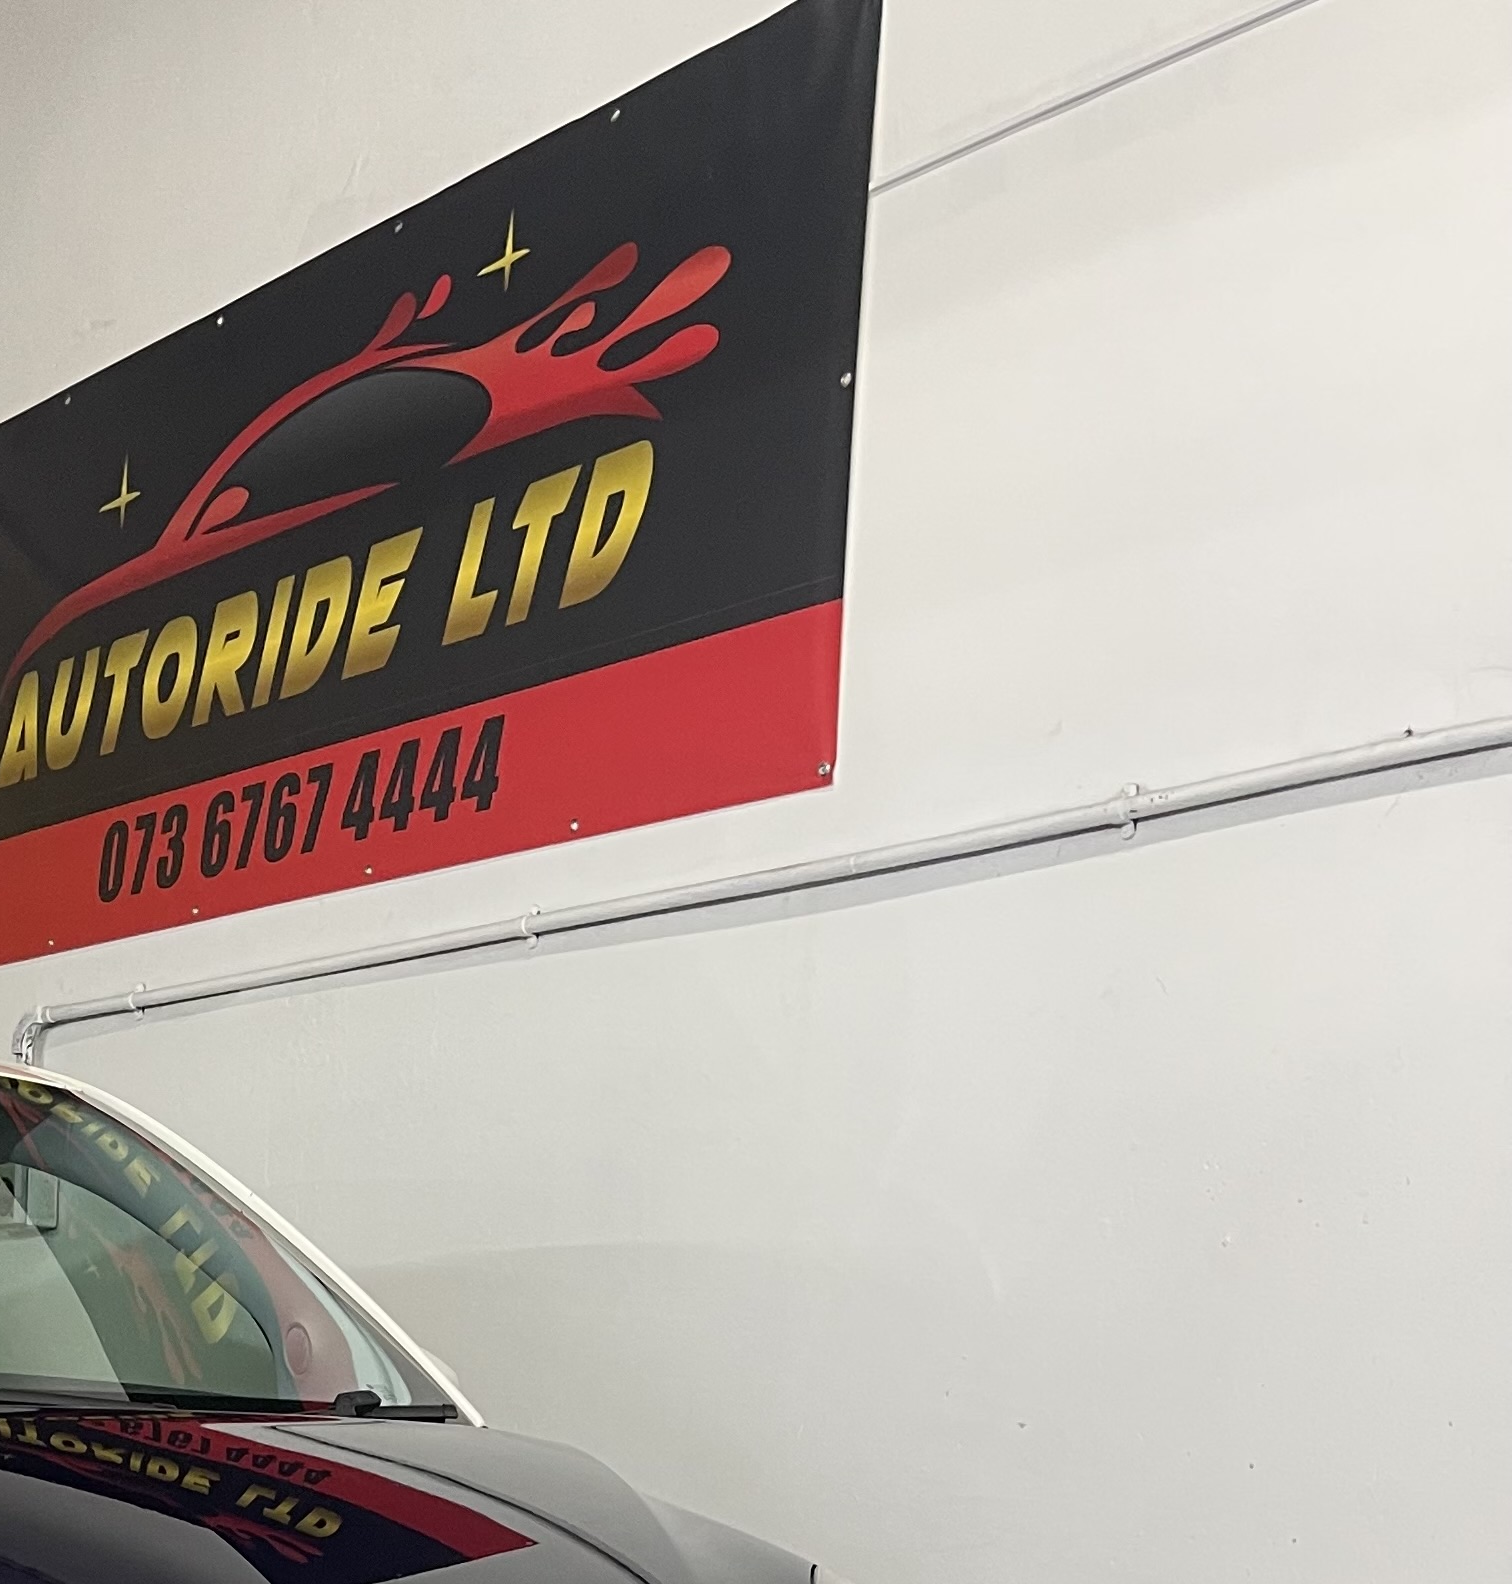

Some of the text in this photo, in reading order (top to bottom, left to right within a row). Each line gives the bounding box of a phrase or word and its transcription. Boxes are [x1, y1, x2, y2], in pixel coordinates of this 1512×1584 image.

[441, 440, 655, 646] LTD
[98, 714, 506, 903] 073 6767 4444
